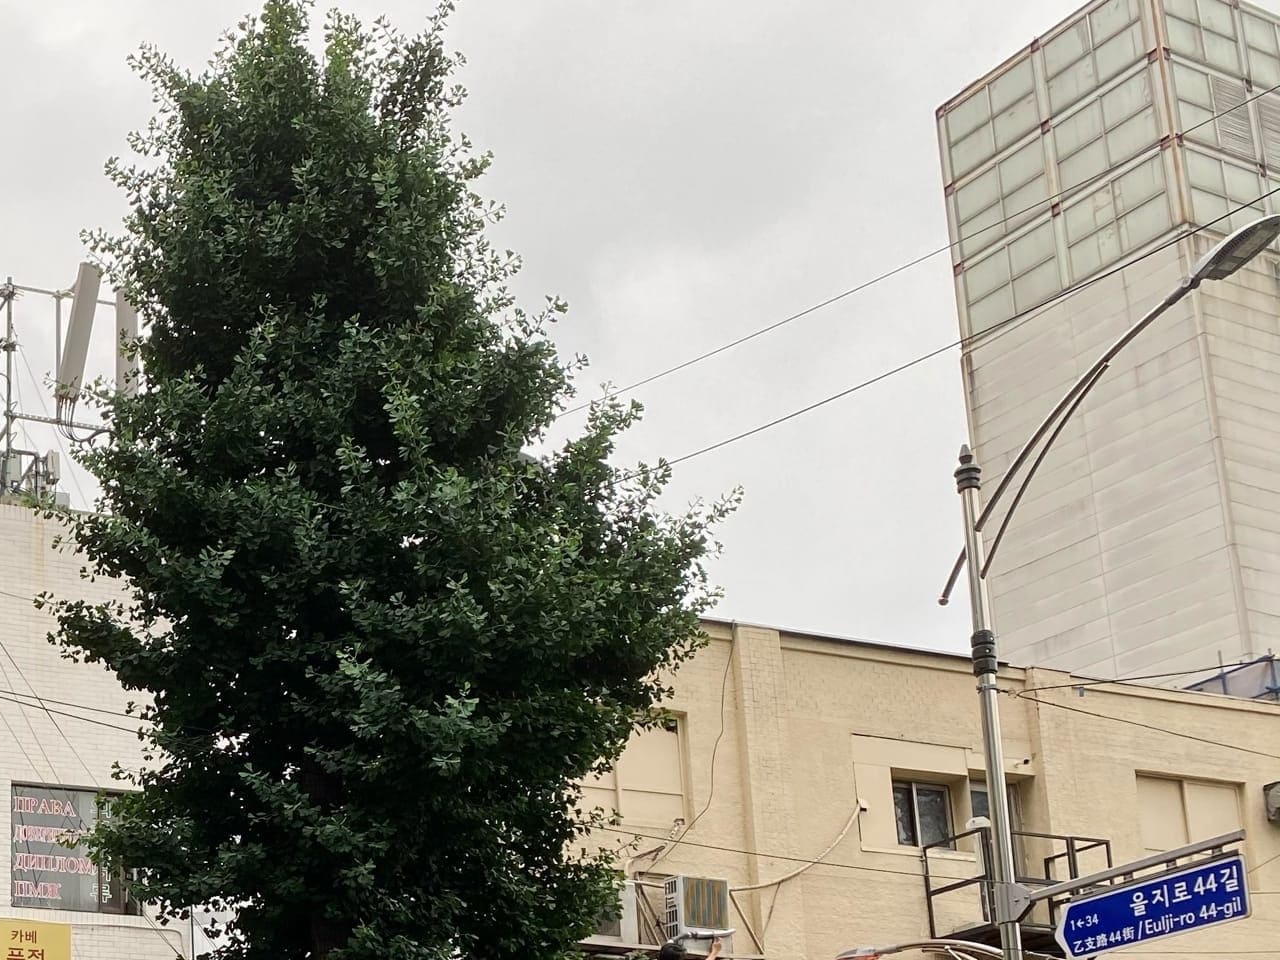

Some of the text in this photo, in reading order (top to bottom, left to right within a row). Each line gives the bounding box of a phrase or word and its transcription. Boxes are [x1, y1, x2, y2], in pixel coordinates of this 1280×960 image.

[13, 796, 76, 817] ПРАВА
[14, 880, 62, 900] ПМЖ
[1085, 914, 1099, 927] 34
[10, 930, 38, 944] 카베
